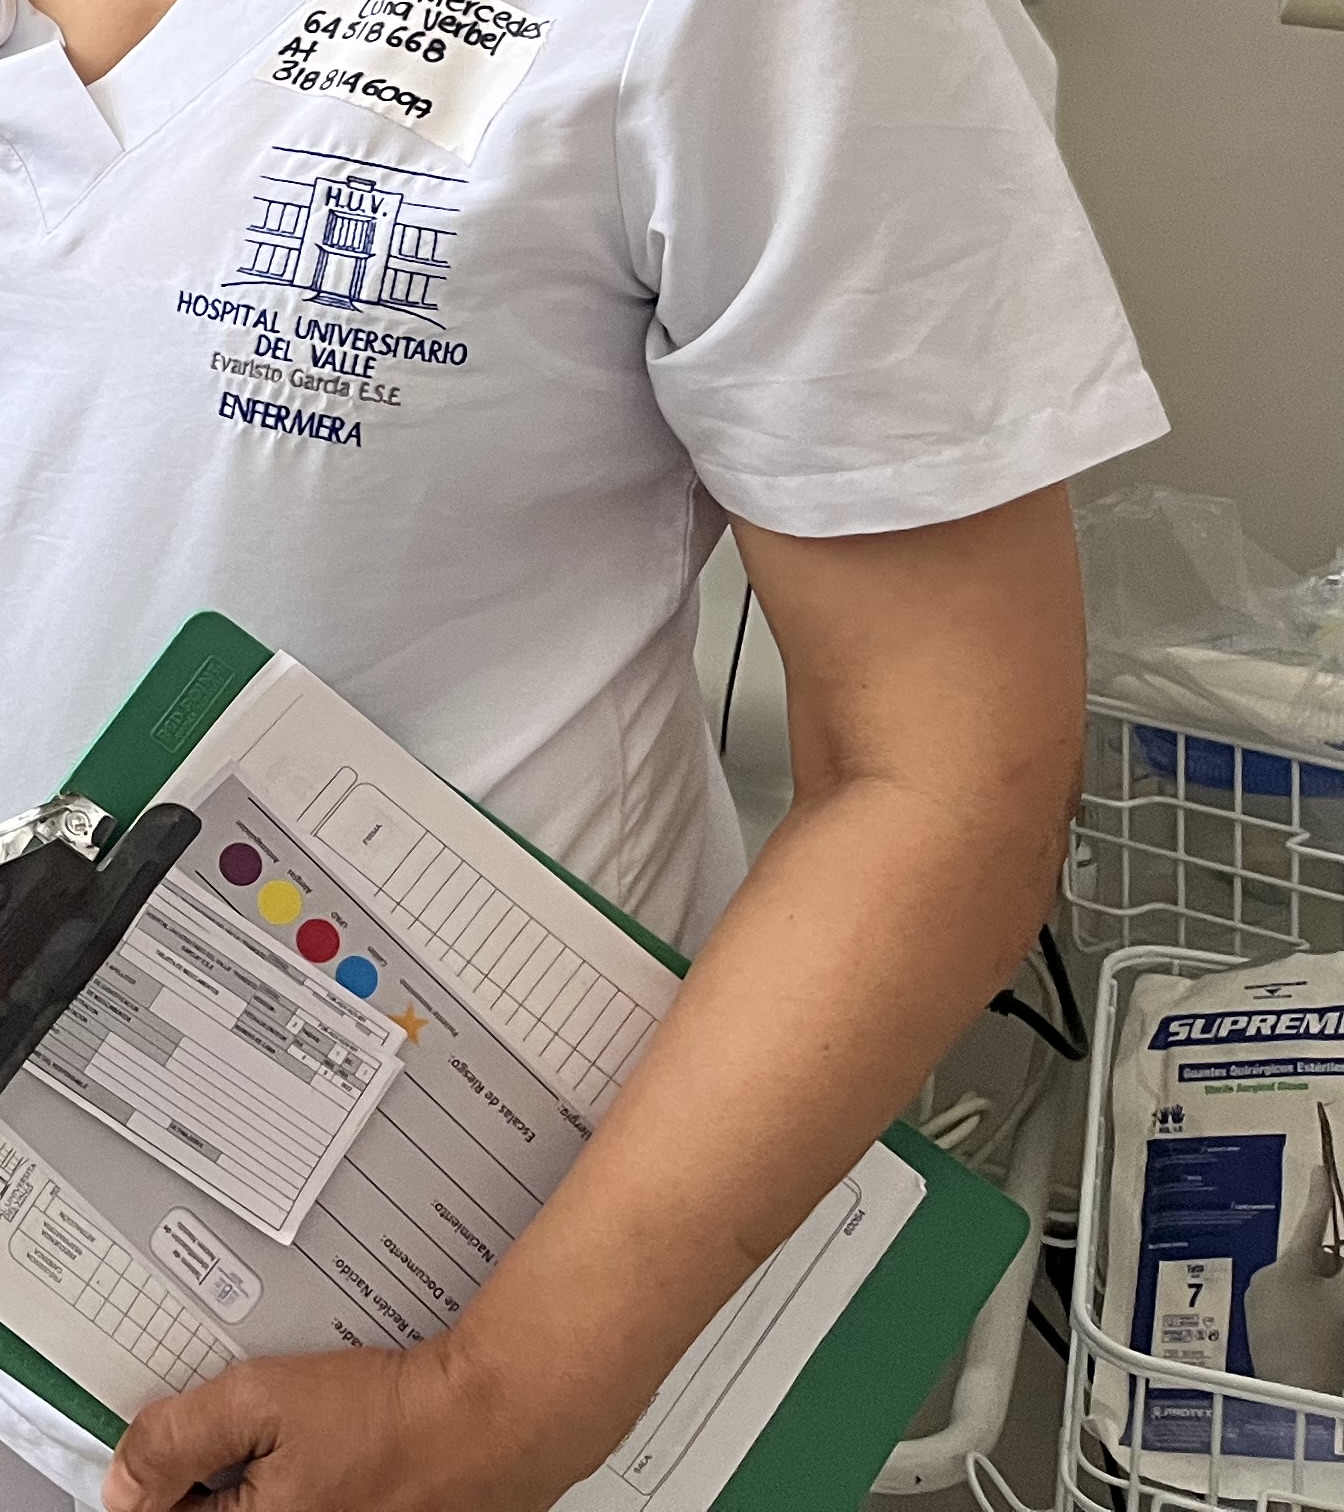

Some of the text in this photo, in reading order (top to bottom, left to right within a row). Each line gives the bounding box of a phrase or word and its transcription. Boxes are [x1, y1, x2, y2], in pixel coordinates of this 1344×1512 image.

[423, 8, 506, 56] Verbel
[177, 290, 468, 366] HOSPITAL UNIVERSITARIO
[210, 351, 283, 384] Evaristo
[254, 334, 377, 379] DEL VALLE
[219, 391, 362, 448] ENFERMERA
[480, 1088, 501, 1109] de
[494, 1102, 538, 1144] Escalas
[426, 1197, 496, 1264] Nacimiento:
[327, 1253, 375, 1299] Nacido:
[375, 1232, 446, 1300] Documento:
[1186, 1282, 1204, 1308] 7
[325, 1315, 364, 1352] adre:
